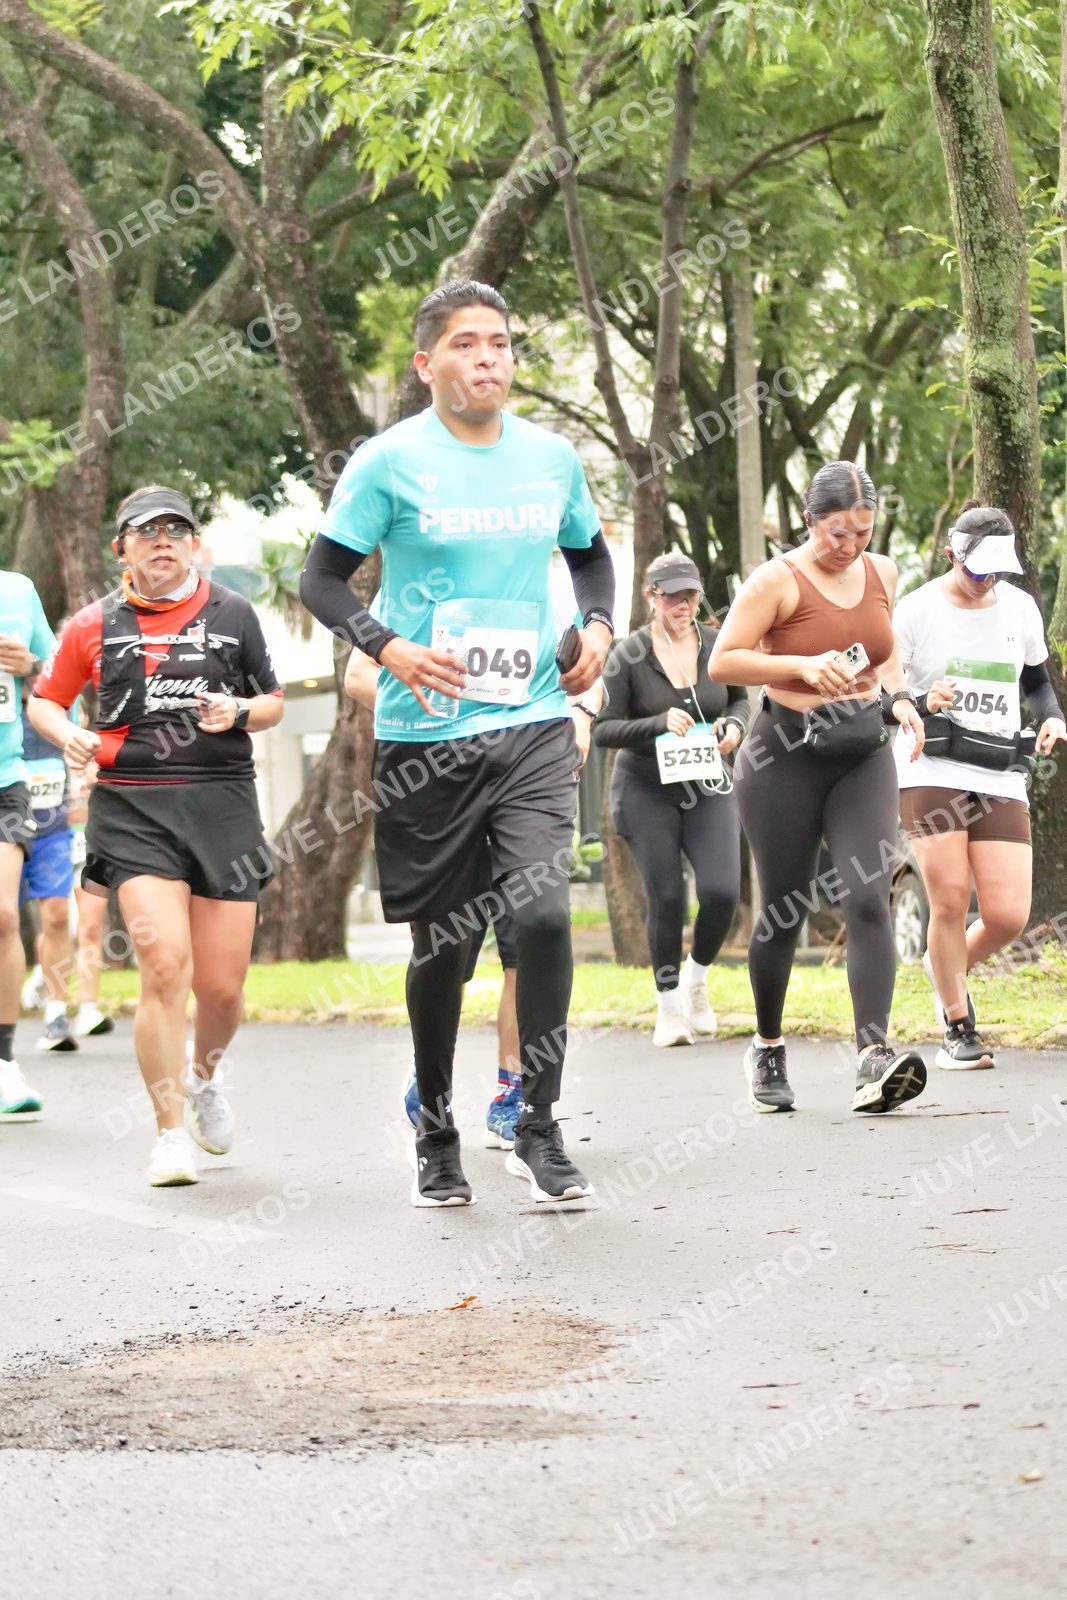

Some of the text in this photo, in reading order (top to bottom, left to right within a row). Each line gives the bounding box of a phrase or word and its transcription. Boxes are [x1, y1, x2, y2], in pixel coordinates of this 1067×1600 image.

[447, 646, 532, 680] 049
[948, 689, 1009, 716] 2054
[663, 746, 715, 768] 5233
